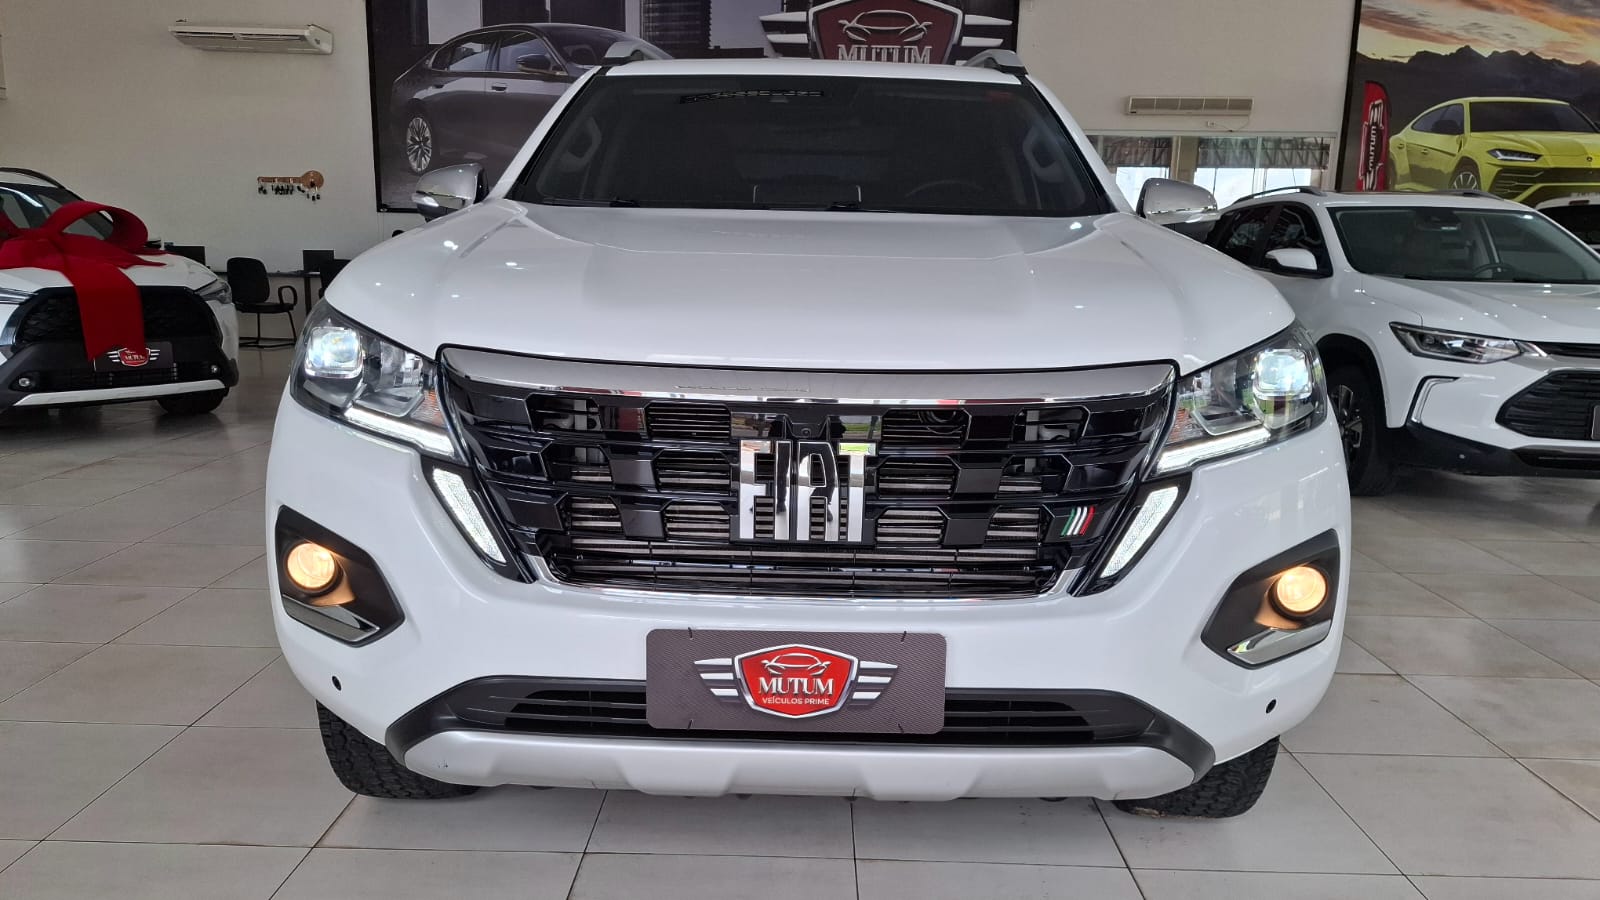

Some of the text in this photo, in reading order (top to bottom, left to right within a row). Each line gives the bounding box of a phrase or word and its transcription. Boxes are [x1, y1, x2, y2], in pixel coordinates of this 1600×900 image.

[739, 439, 877, 543] FIAT
[758, 677, 834, 695] MUTUM
[762, 695, 830, 706] VEÍCULOS PRIME
